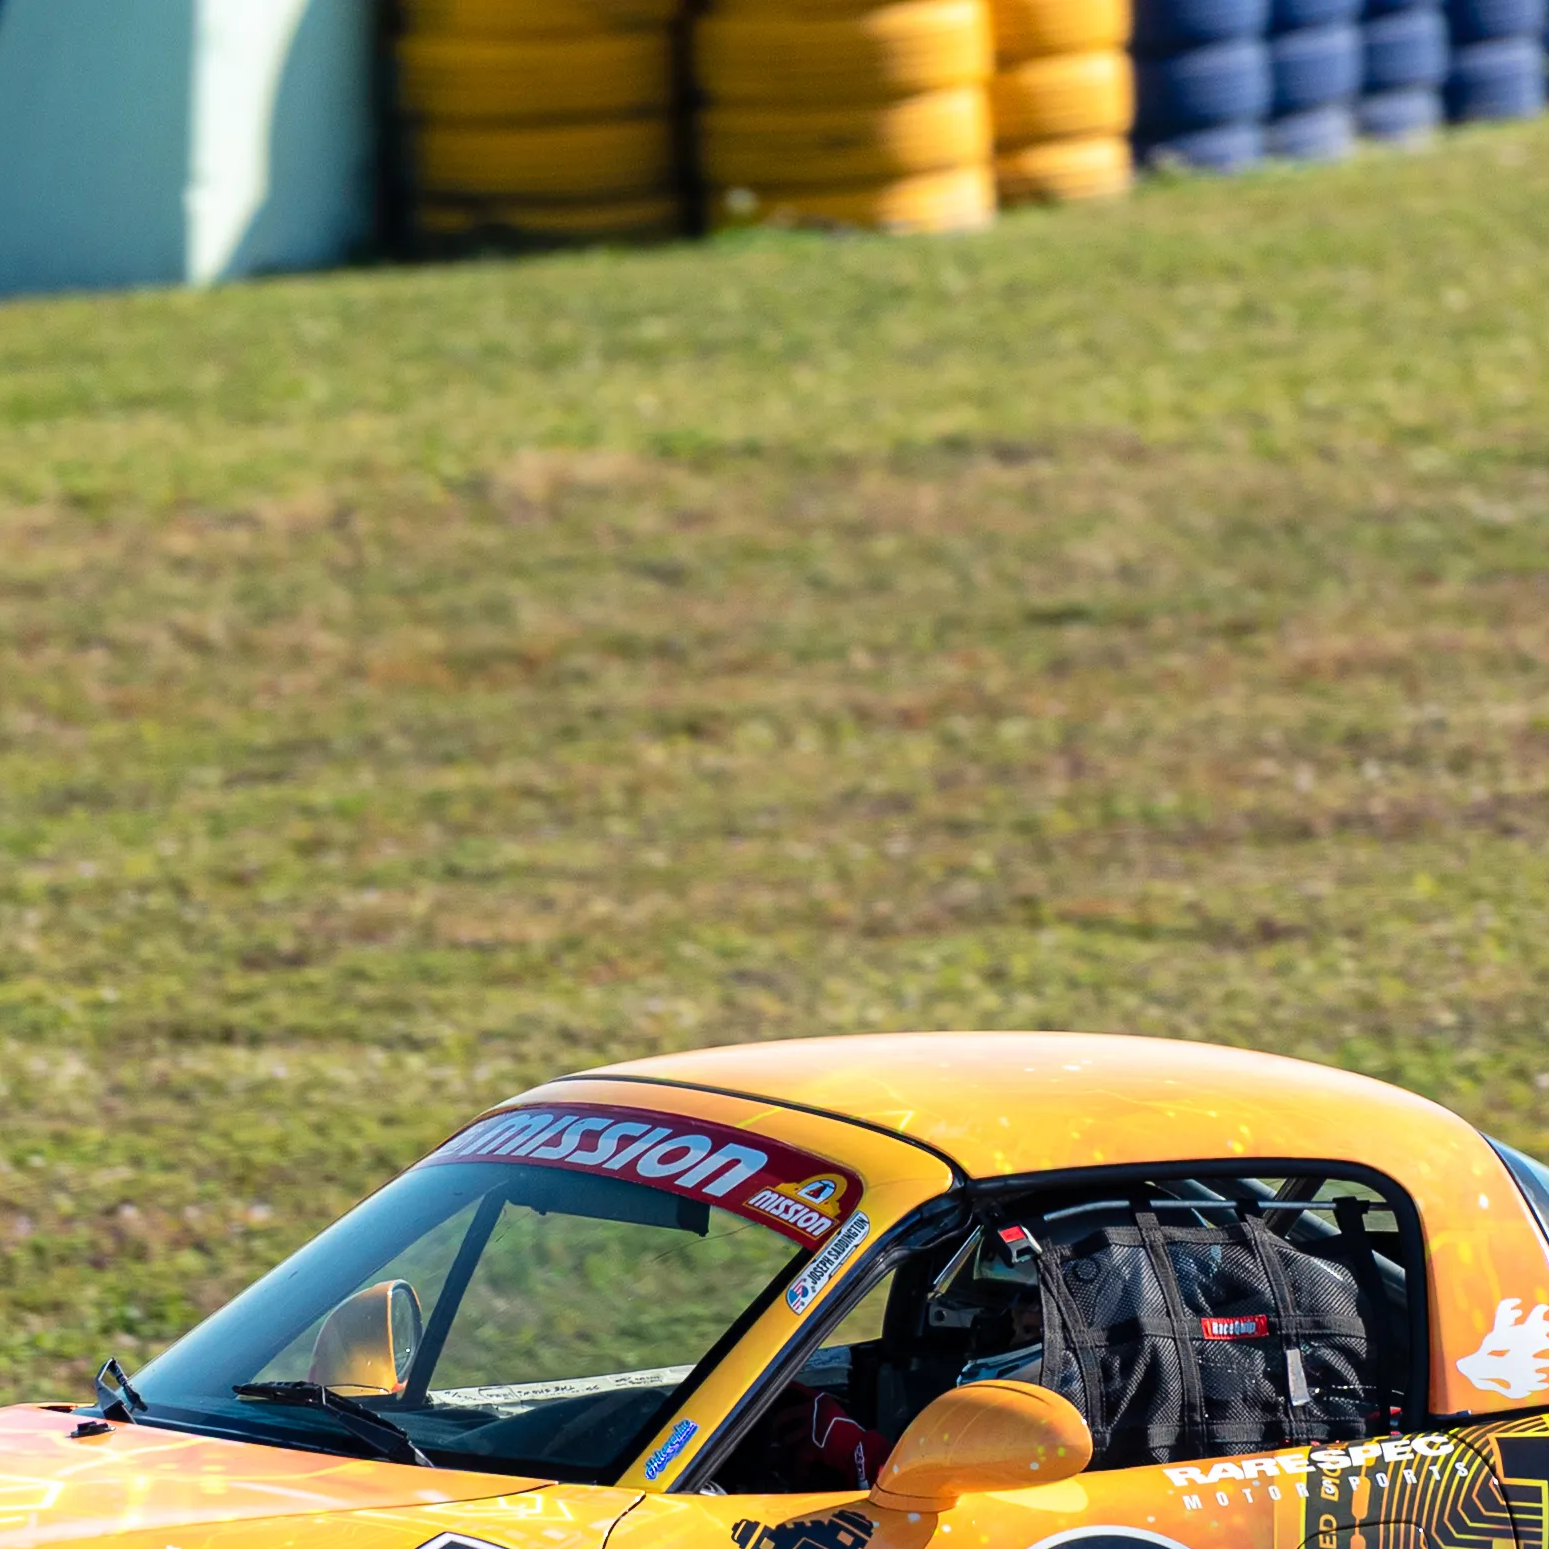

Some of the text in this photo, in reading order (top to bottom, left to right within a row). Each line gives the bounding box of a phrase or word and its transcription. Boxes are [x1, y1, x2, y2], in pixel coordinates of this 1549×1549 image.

[806, 1216, 870, 1285] JOSEPH SADDINGTON
[1162, 1434, 1454, 1487] RARESPEC
